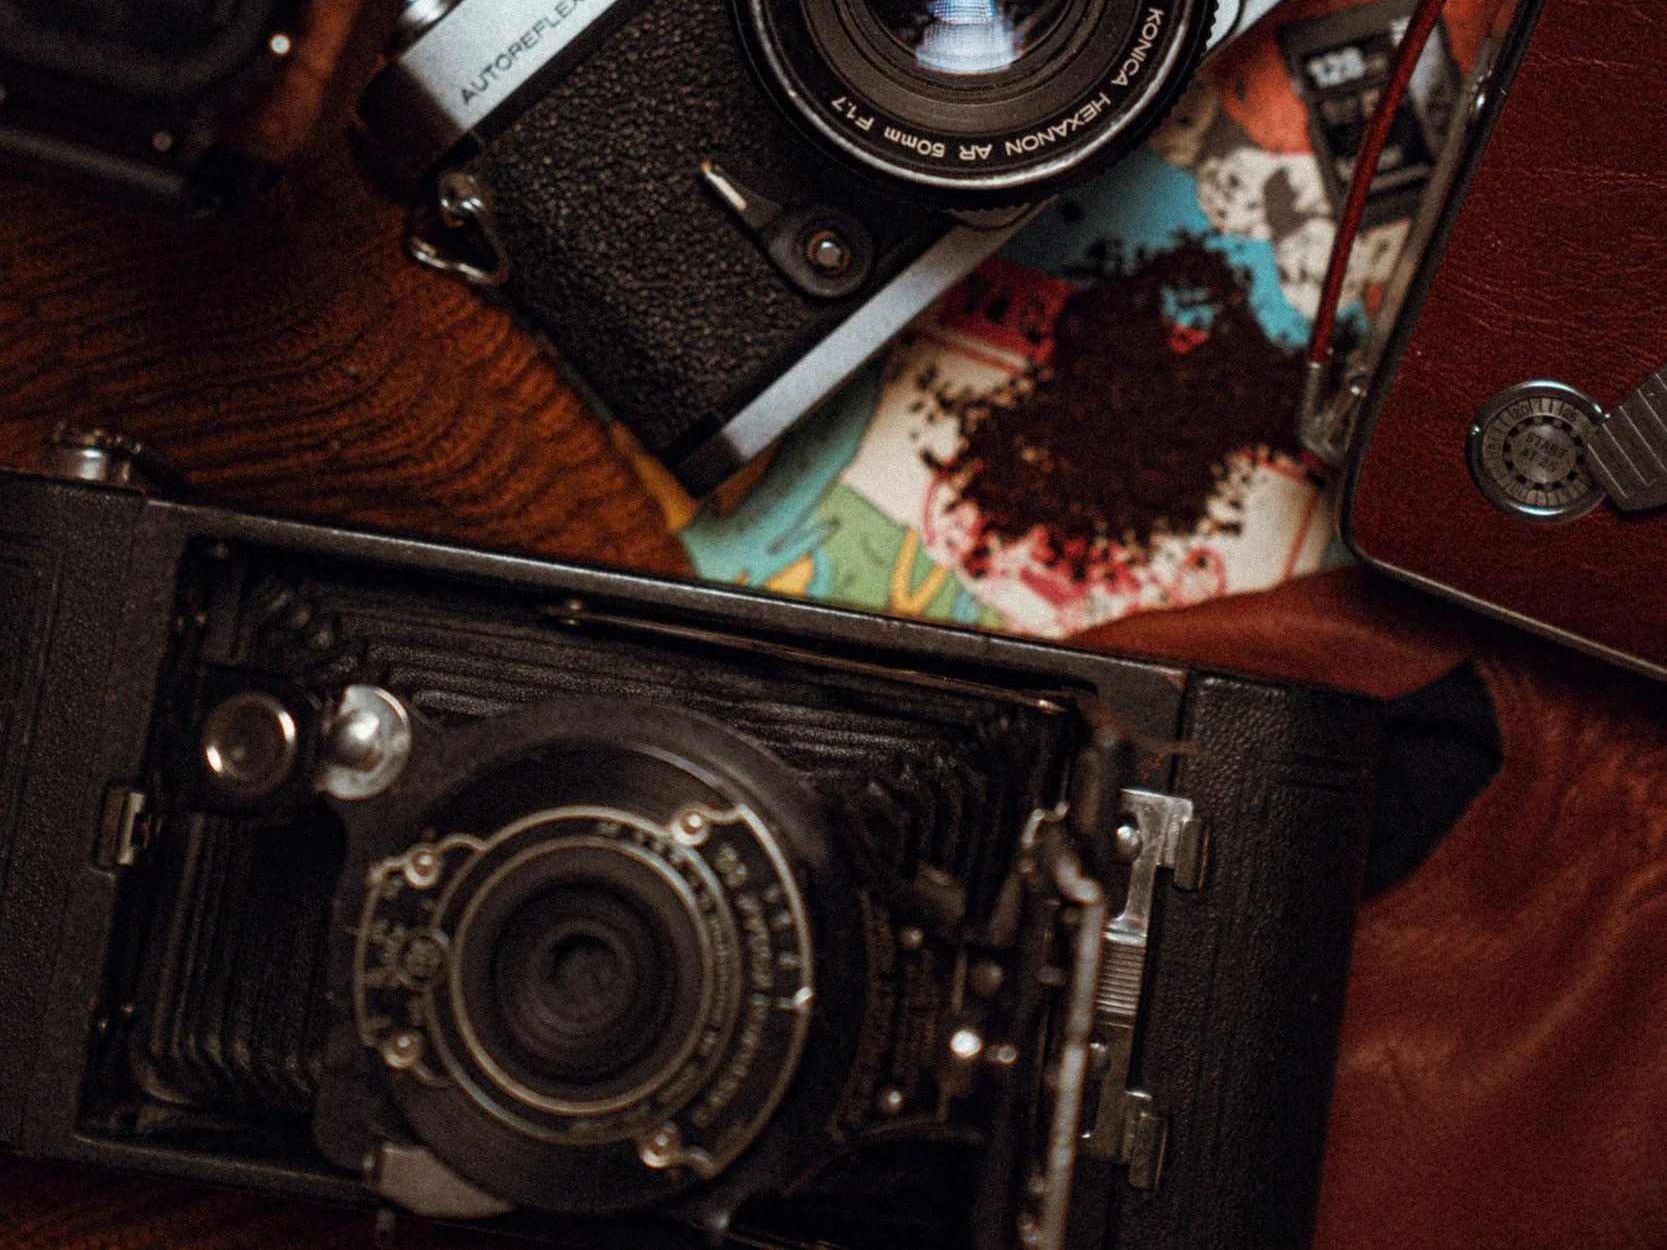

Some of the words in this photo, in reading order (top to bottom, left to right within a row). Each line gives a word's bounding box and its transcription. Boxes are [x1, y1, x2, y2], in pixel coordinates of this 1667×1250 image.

[1110, 5, 1165, 87] KONICA
[1004, 90, 1112, 157] HEXANON
[882, 125, 946, 159] 50mm
[957, 142, 993, 161] AR
[1525, 432, 1568, 459] START
